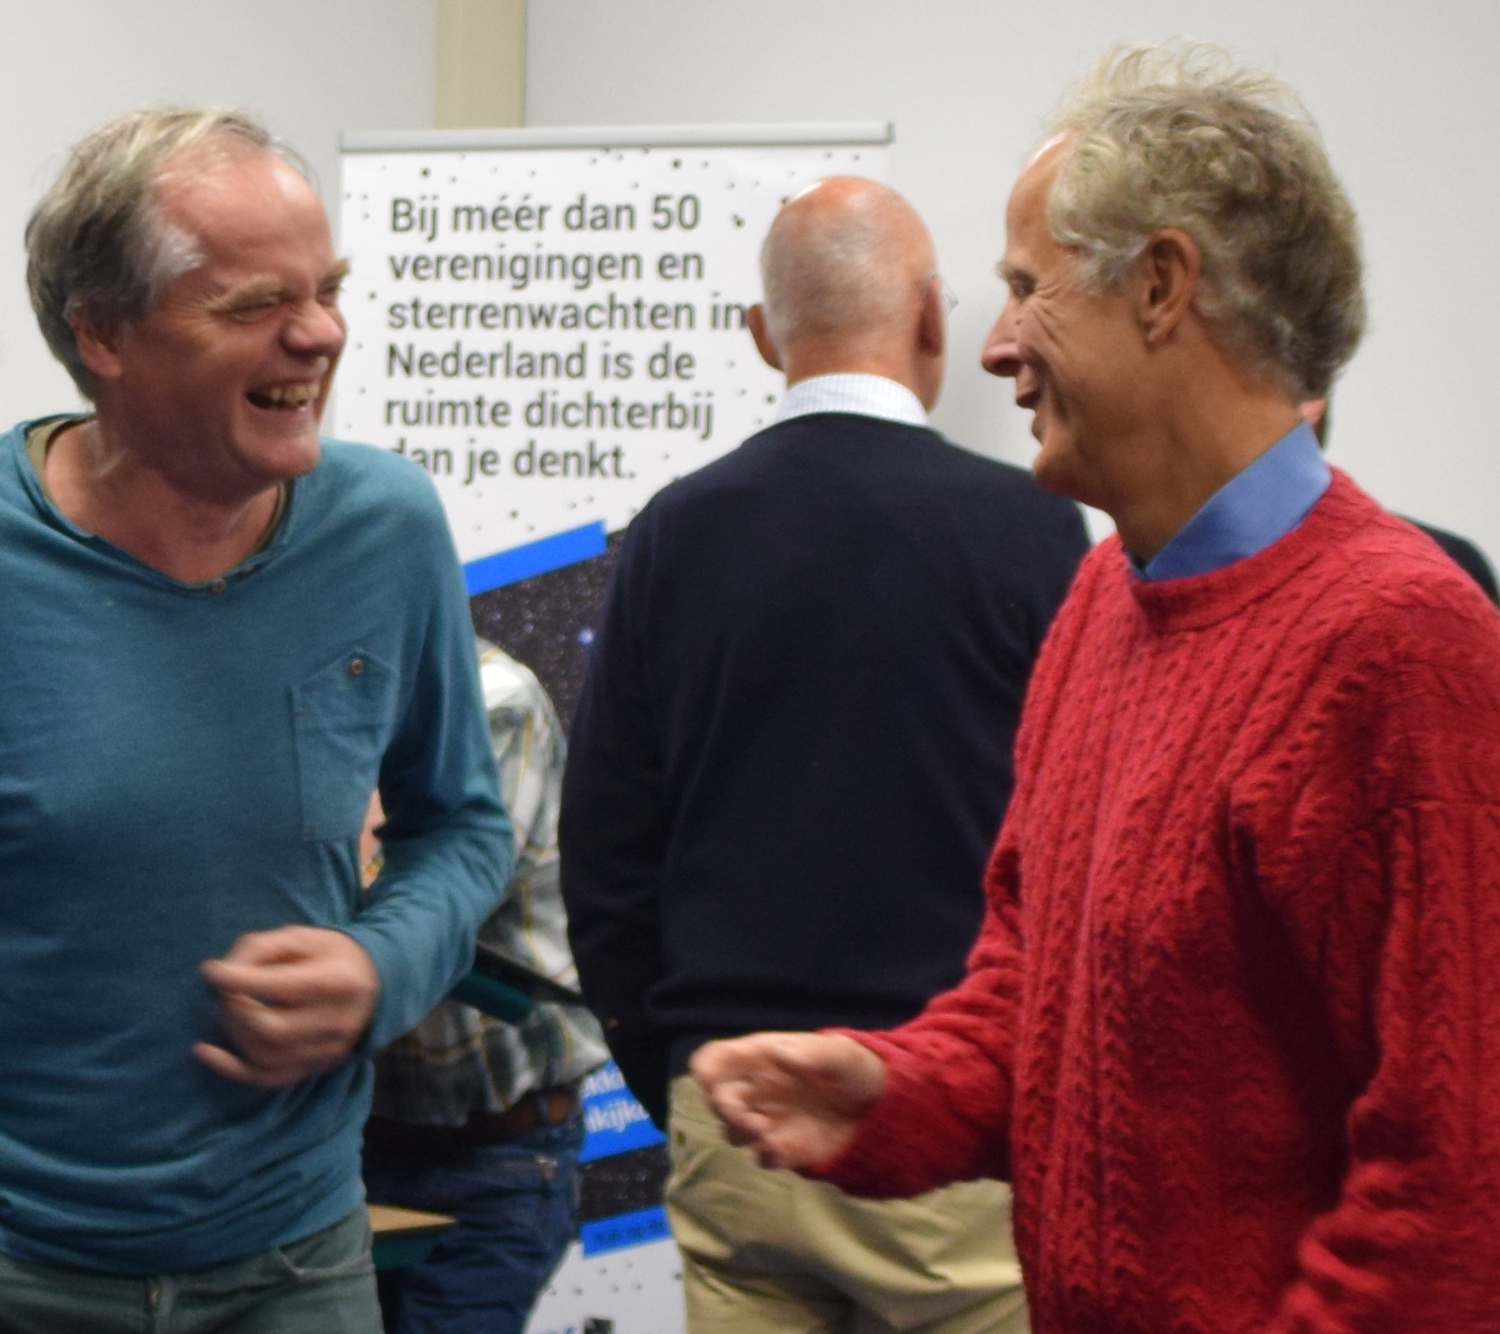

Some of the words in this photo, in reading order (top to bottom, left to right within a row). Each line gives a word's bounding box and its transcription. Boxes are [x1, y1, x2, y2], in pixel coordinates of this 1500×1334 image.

[389, 194, 439, 243] Bij
[452, 194, 552, 233] méér
[563, 192, 637, 232] dan
[651, 192, 702, 232] 50
[388, 241, 643, 292] verenigingen
[656, 251, 705, 282] en
[387, 290, 696, 332] sterrenwachten
[710, 290, 747, 331] in
[385, 340, 588, 380] Nederland
[601, 340, 634, 380] is
[648, 340, 697, 381] de
[384, 388, 513, 429] ruimte
[523, 389, 715, 442] dichterbij
[463, 438, 501, 486] je
[512, 439, 637, 479] denkt.
